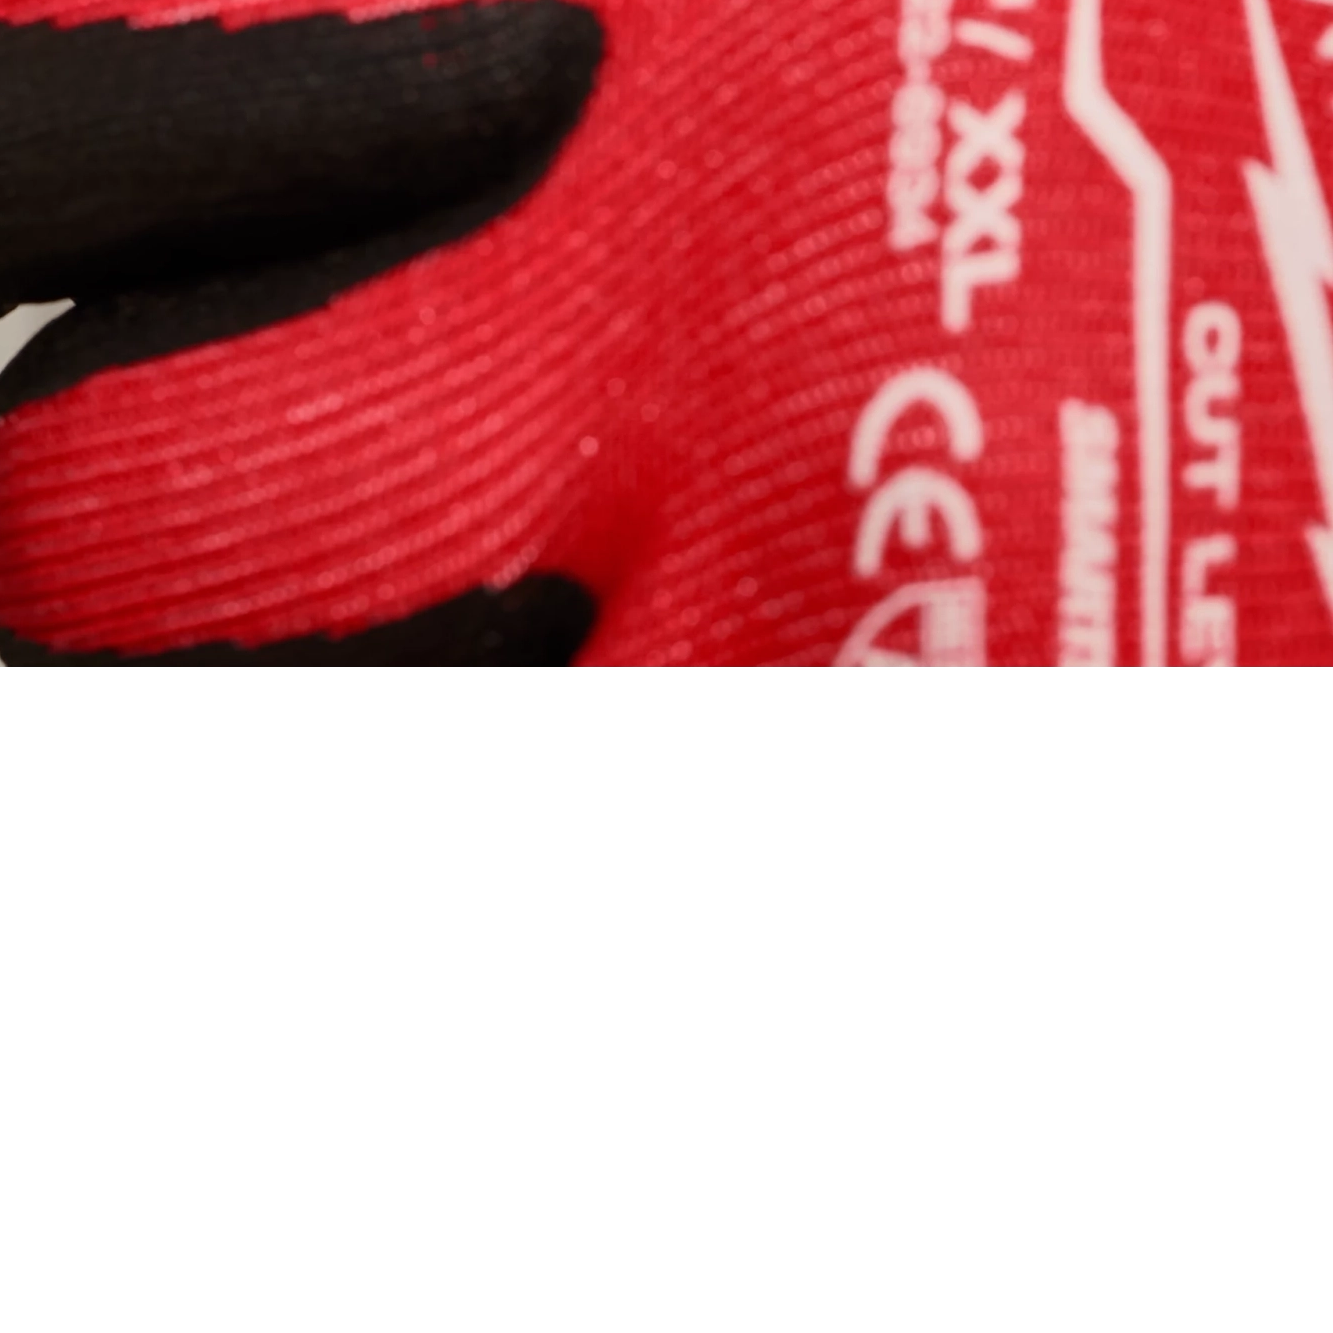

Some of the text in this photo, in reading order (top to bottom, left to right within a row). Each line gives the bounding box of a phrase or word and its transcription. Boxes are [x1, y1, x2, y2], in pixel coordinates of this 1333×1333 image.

[848, 365, 984, 575] CE
[1179, 300, 1242, 668] CUT LE
